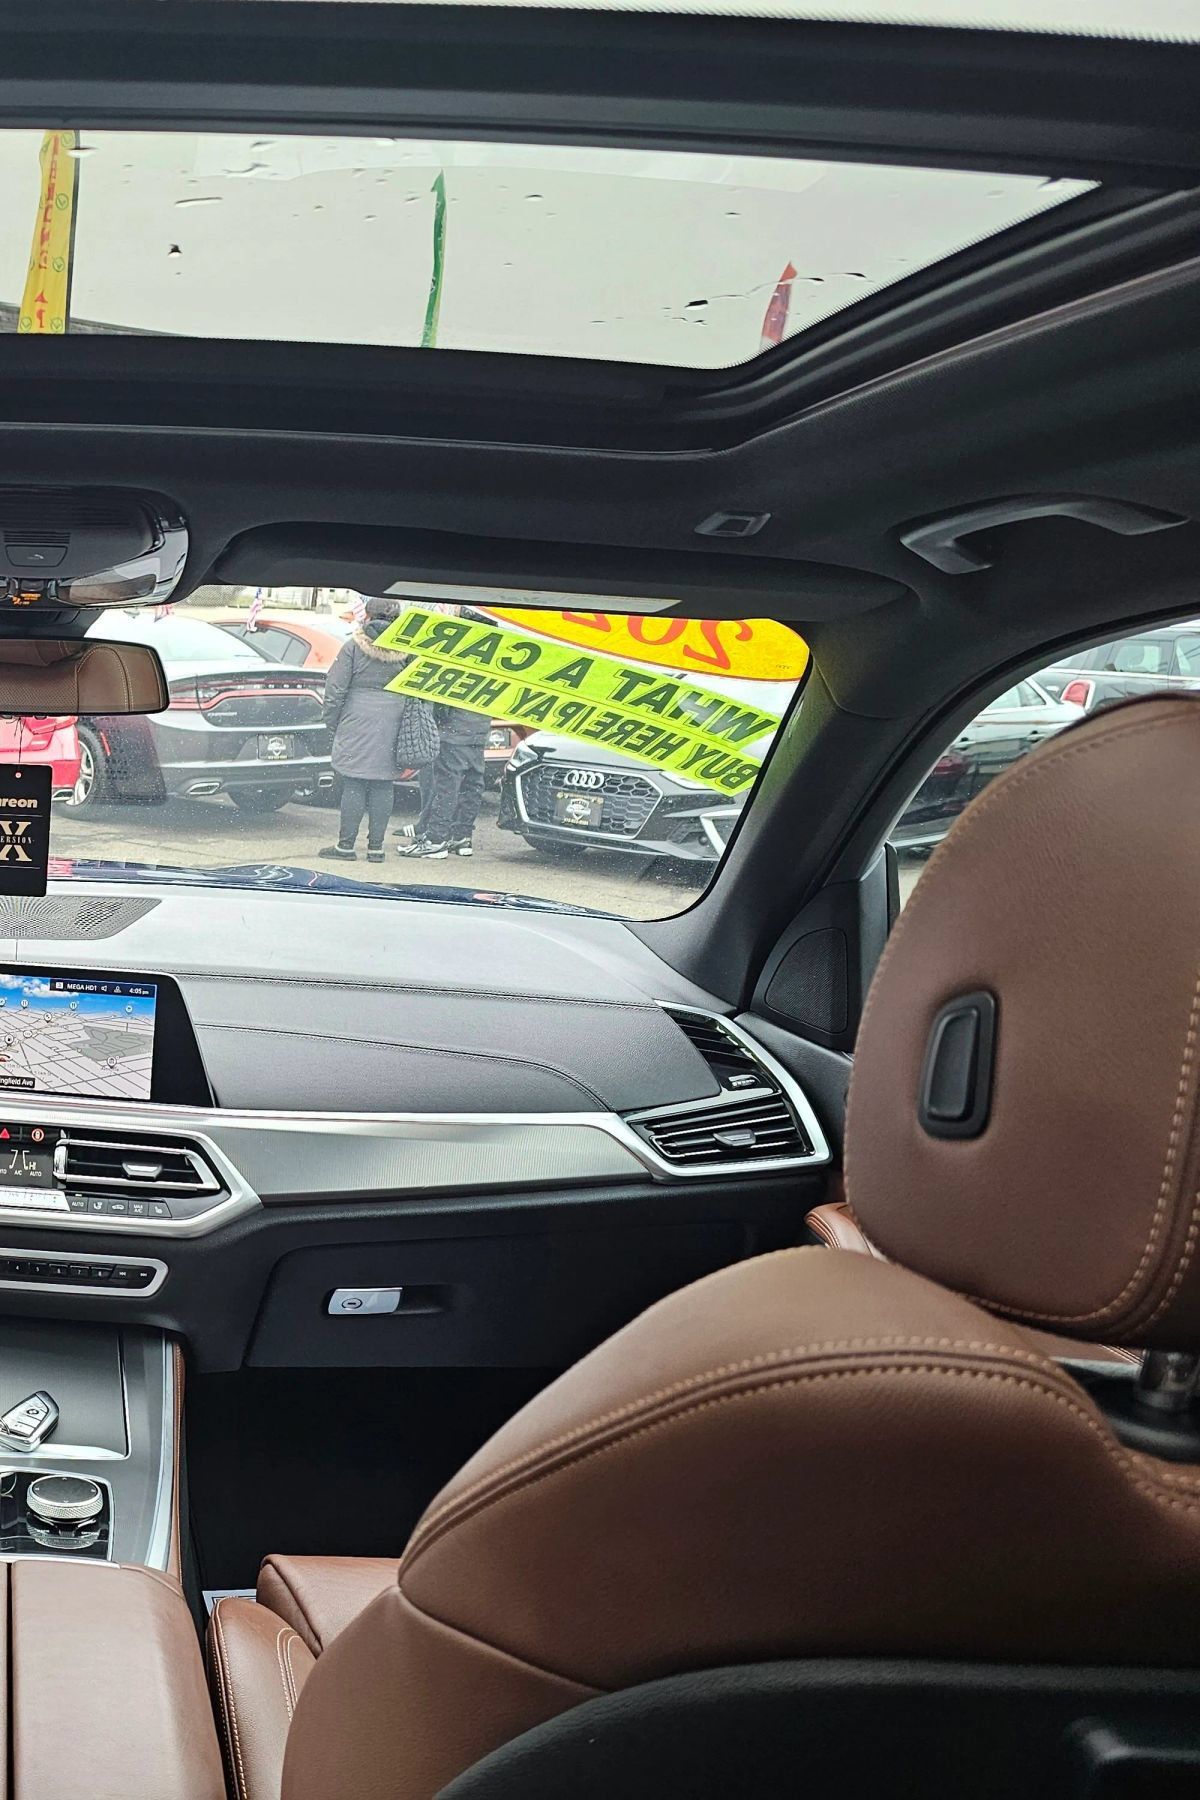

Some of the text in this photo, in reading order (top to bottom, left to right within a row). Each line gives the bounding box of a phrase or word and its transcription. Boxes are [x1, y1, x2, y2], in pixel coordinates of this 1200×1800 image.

[67, 983, 97, 992] MEGA HD1
[128, 987, 143, 995] 4:05
[21, 1078, 34, 1087] Ave
[28, 1161, 37, 1170] HI
